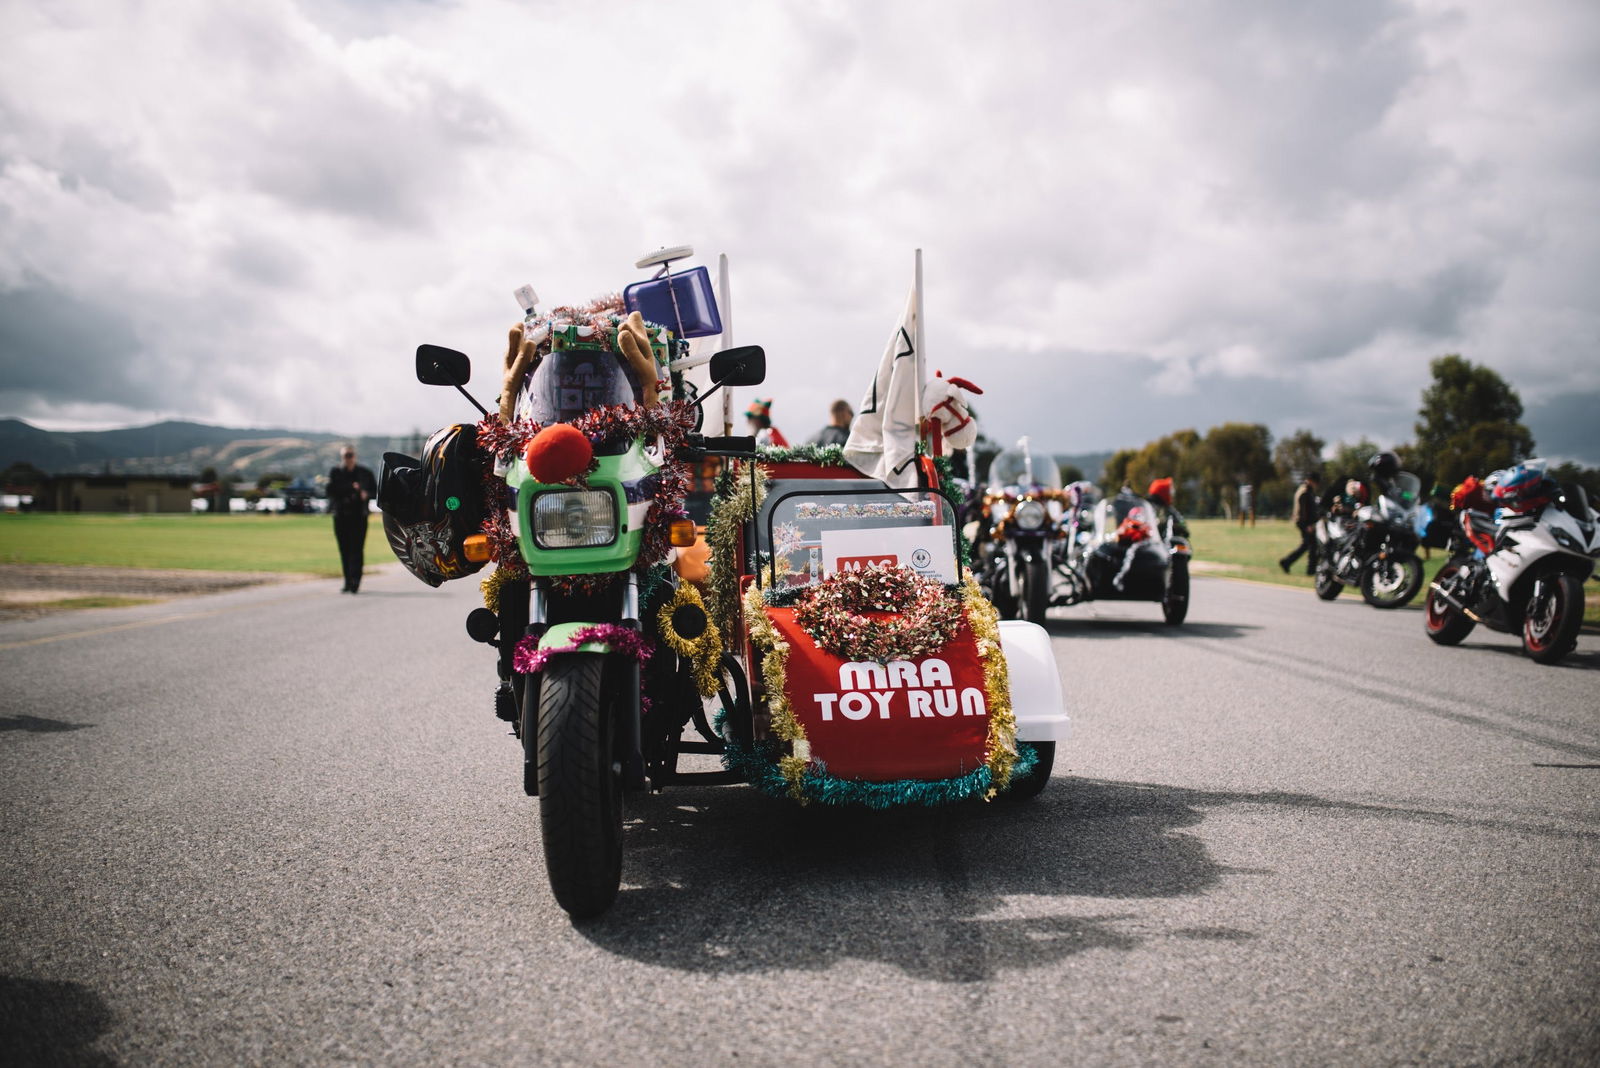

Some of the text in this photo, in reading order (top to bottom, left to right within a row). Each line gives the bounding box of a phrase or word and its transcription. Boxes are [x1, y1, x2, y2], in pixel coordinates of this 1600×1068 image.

[838, 658, 953, 690] MRA
[813, 687, 986, 721] TOY RUN
